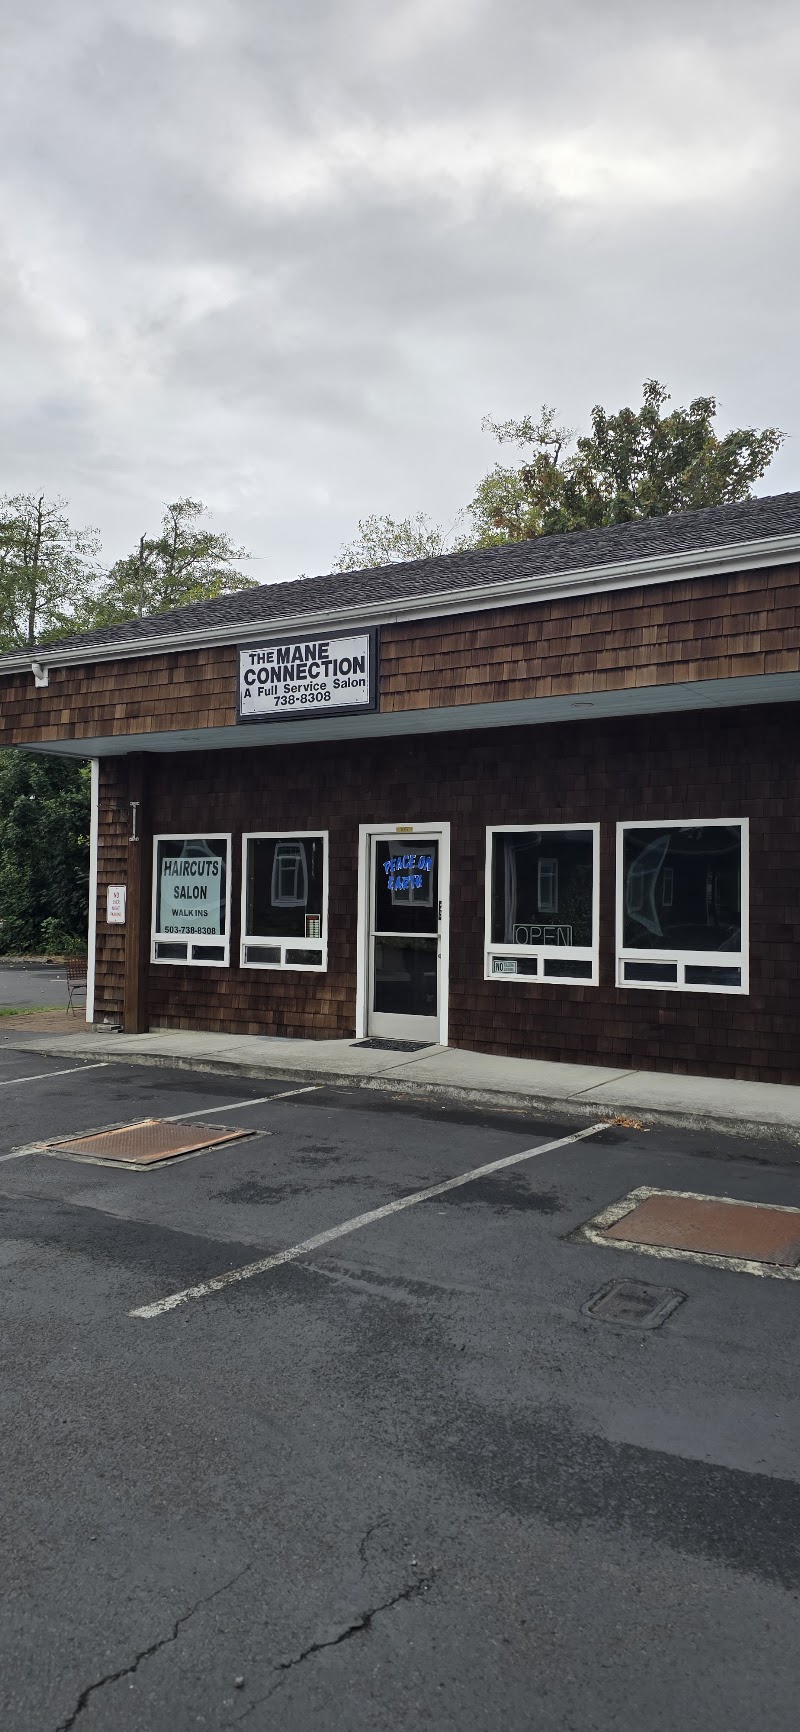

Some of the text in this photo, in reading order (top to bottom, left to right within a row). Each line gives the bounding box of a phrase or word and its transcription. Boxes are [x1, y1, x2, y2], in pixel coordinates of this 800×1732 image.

[249, 642, 330, 666] THE MANE
[243, 656, 366, 686] CONNECTION
[243, 677, 366, 698] A Full Service Salon
[274, 691, 331, 706] 738-8308
[163, 860, 219, 877] HAIRCUTS
[382, 854, 433, 874] PEACE ON
[173, 885, 208, 900] SALON
[171, 909, 194, 917] WALK
[164, 926, 216, 935] 503-738-8308
[515, 926, 570, 946] OPEN
[495, 962, 504, 972] NO
